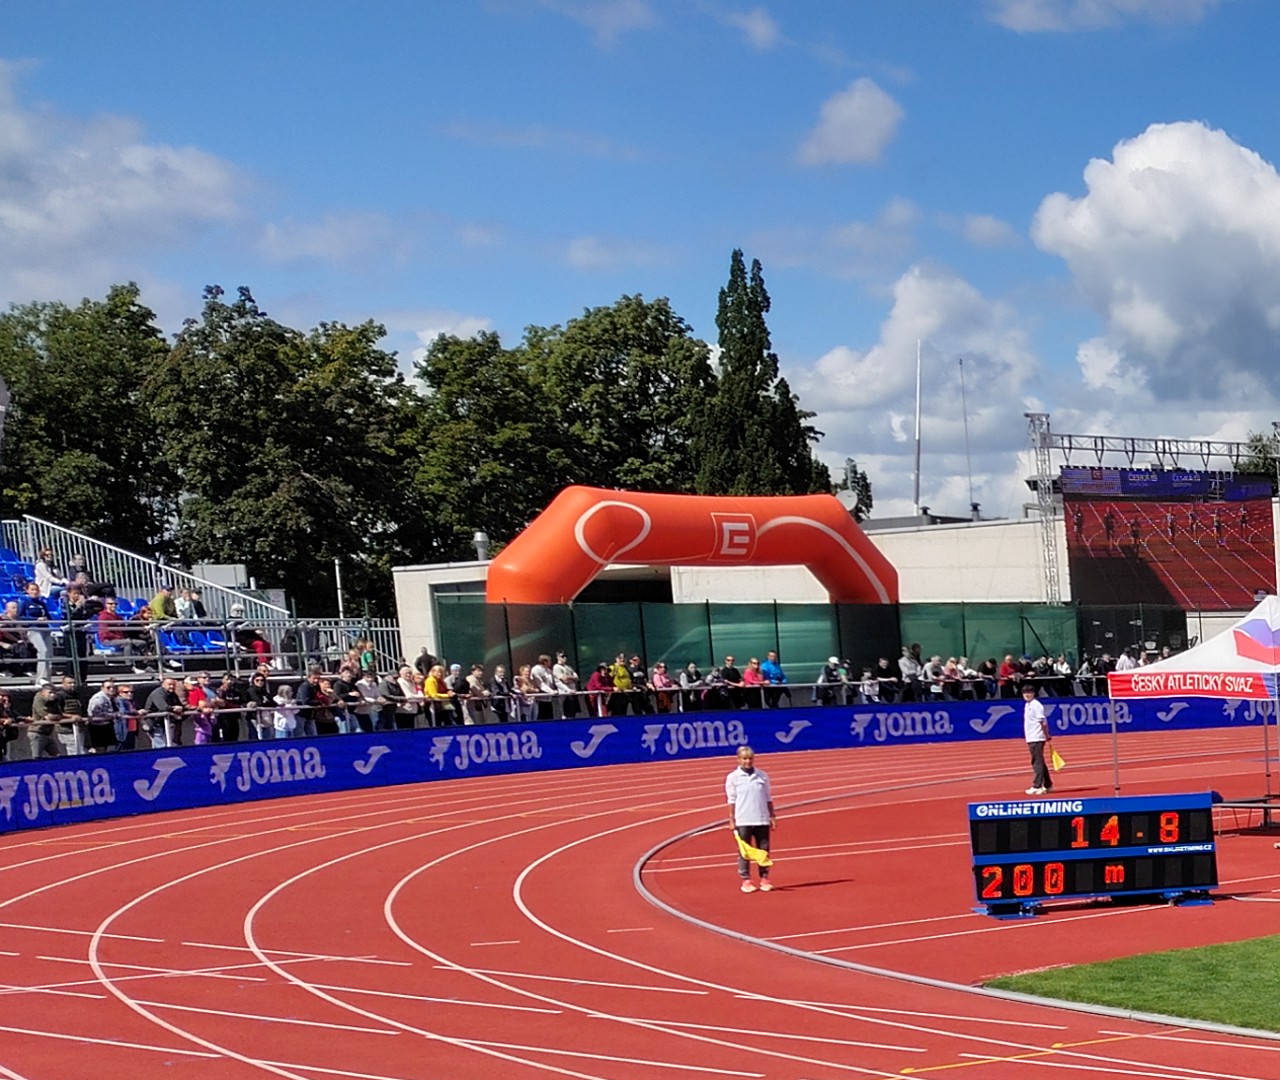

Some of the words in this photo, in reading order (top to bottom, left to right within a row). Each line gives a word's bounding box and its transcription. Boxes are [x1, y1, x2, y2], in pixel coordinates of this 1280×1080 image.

[1131, 673, 1165, 692] ČESKÝ
[1167, 673, 1223, 691] ATLETICKÝ
[1225, 677, 1253, 692] SVAZ
[873, 708, 954, 742] Joma
[1056, 700, 1133, 731] Joma
[454, 730, 543, 770] Joma
[665, 719, 748, 755] Joma
[236, 746, 327, 793] Joma
[23, 767, 116, 820] Joma
[976, 800, 1083, 817] ONLINETIMING
[982, 862, 1065, 899] 200
[1104, 864, 1125, 885] m
